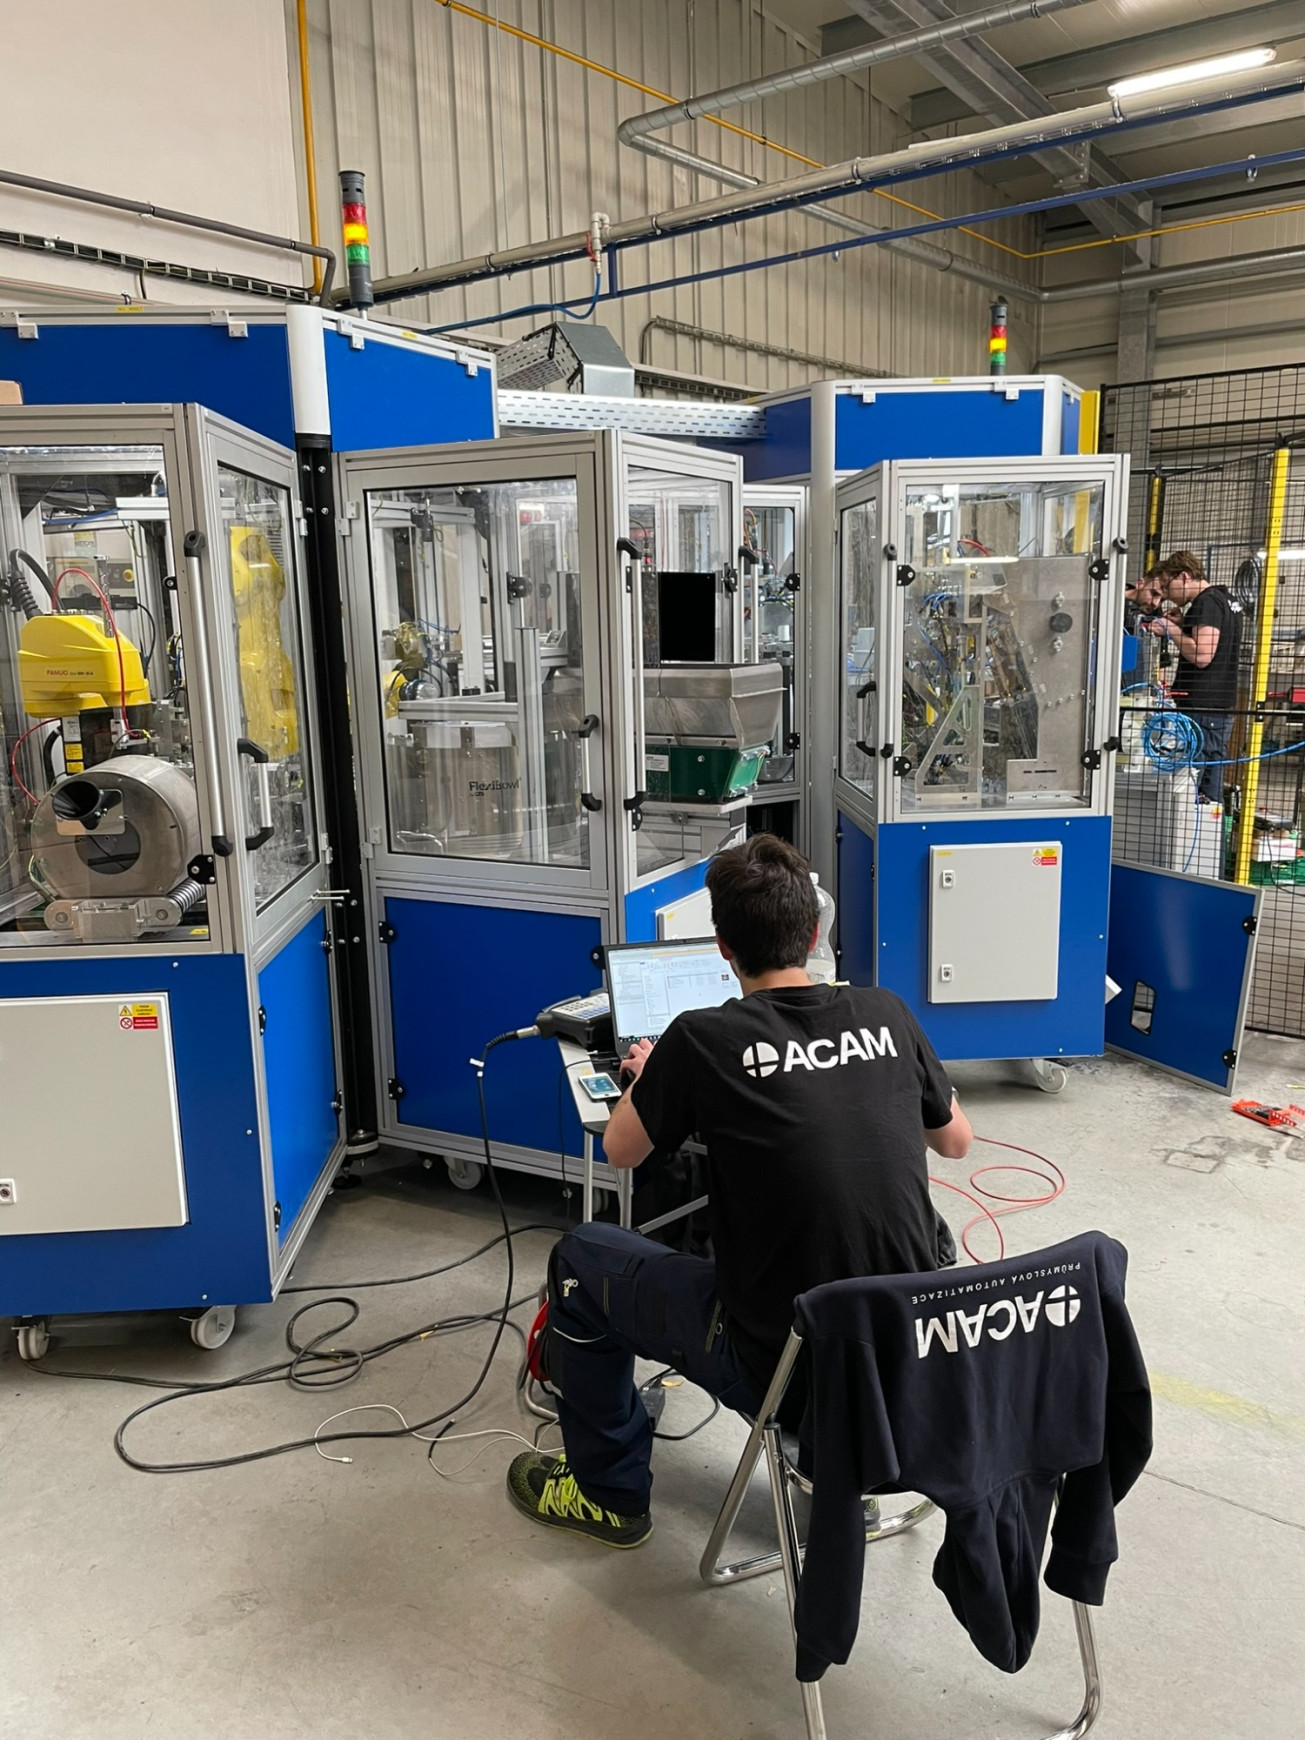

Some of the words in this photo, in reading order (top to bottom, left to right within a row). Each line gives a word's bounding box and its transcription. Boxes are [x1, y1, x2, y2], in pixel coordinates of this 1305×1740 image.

[469, 779, 520, 791] FlexiBowl
[783, 1026, 898, 1072] ACAM
[1011, 1262, 1081, 1285] PRŮMYSLOVÁ
[911, 1278, 1006, 1305] AUTOMATIZACE
[914, 1290, 1044, 1359] ACAM
